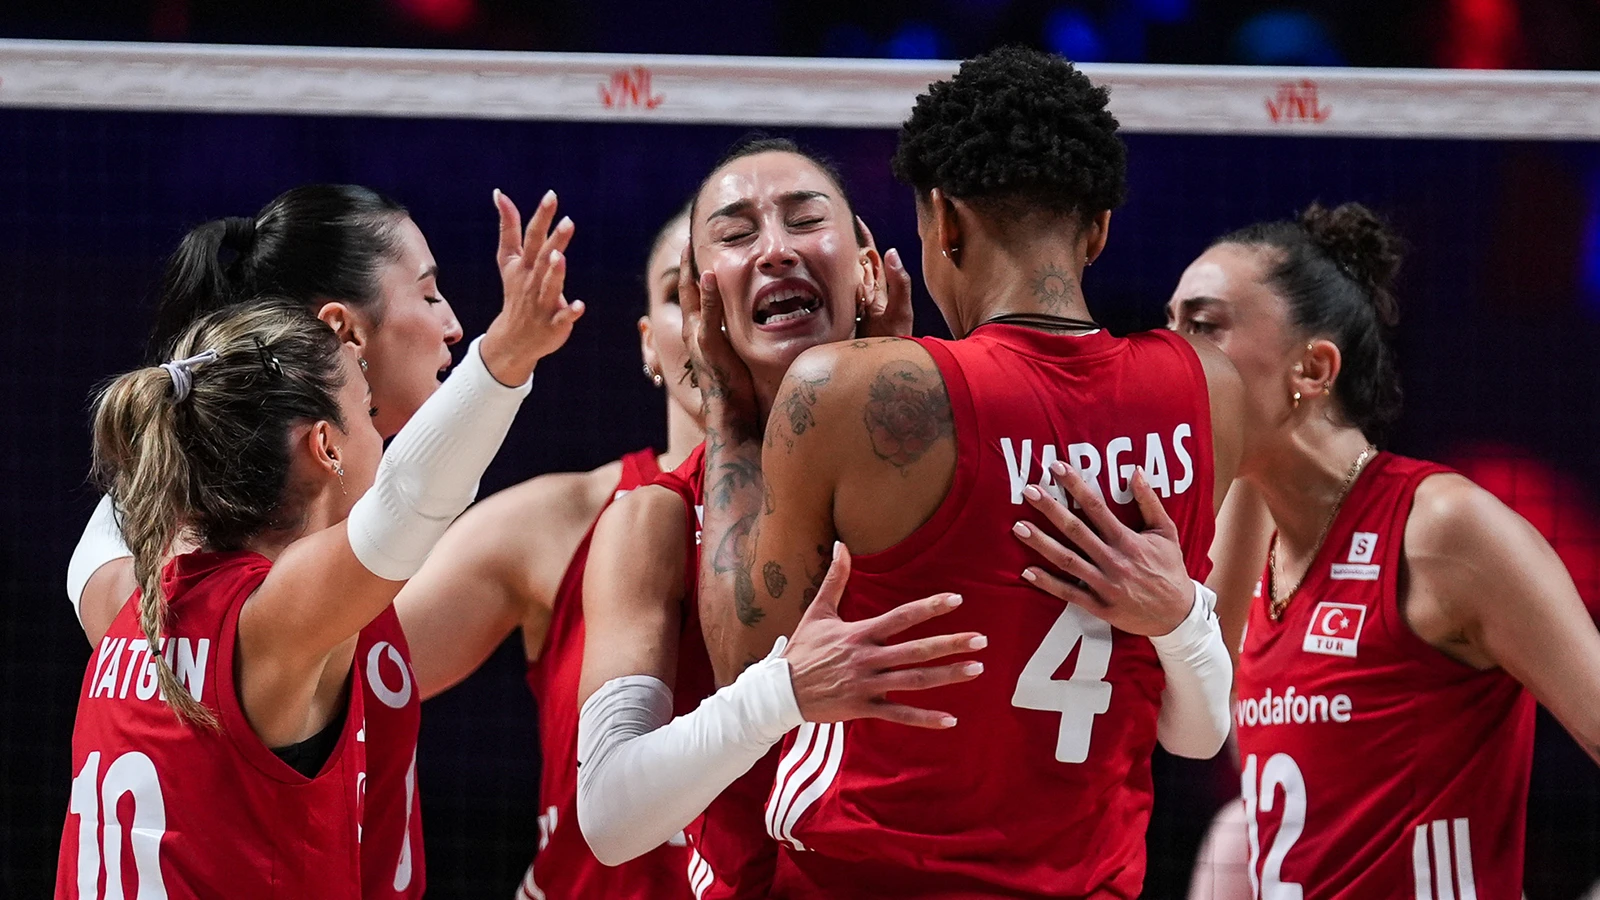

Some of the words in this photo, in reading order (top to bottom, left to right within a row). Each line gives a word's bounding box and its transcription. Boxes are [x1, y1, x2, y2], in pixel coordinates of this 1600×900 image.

[1000, 423, 1194, 509] VARGAS
[1355, 538, 1369, 555] S
[1011, 600, 1113, 764] 4
[1317, 638, 1344, 651] TUR
[1236, 686, 1353, 727] vodafone
[70, 751, 168, 900] 10
[1241, 753, 1307, 900] 12
